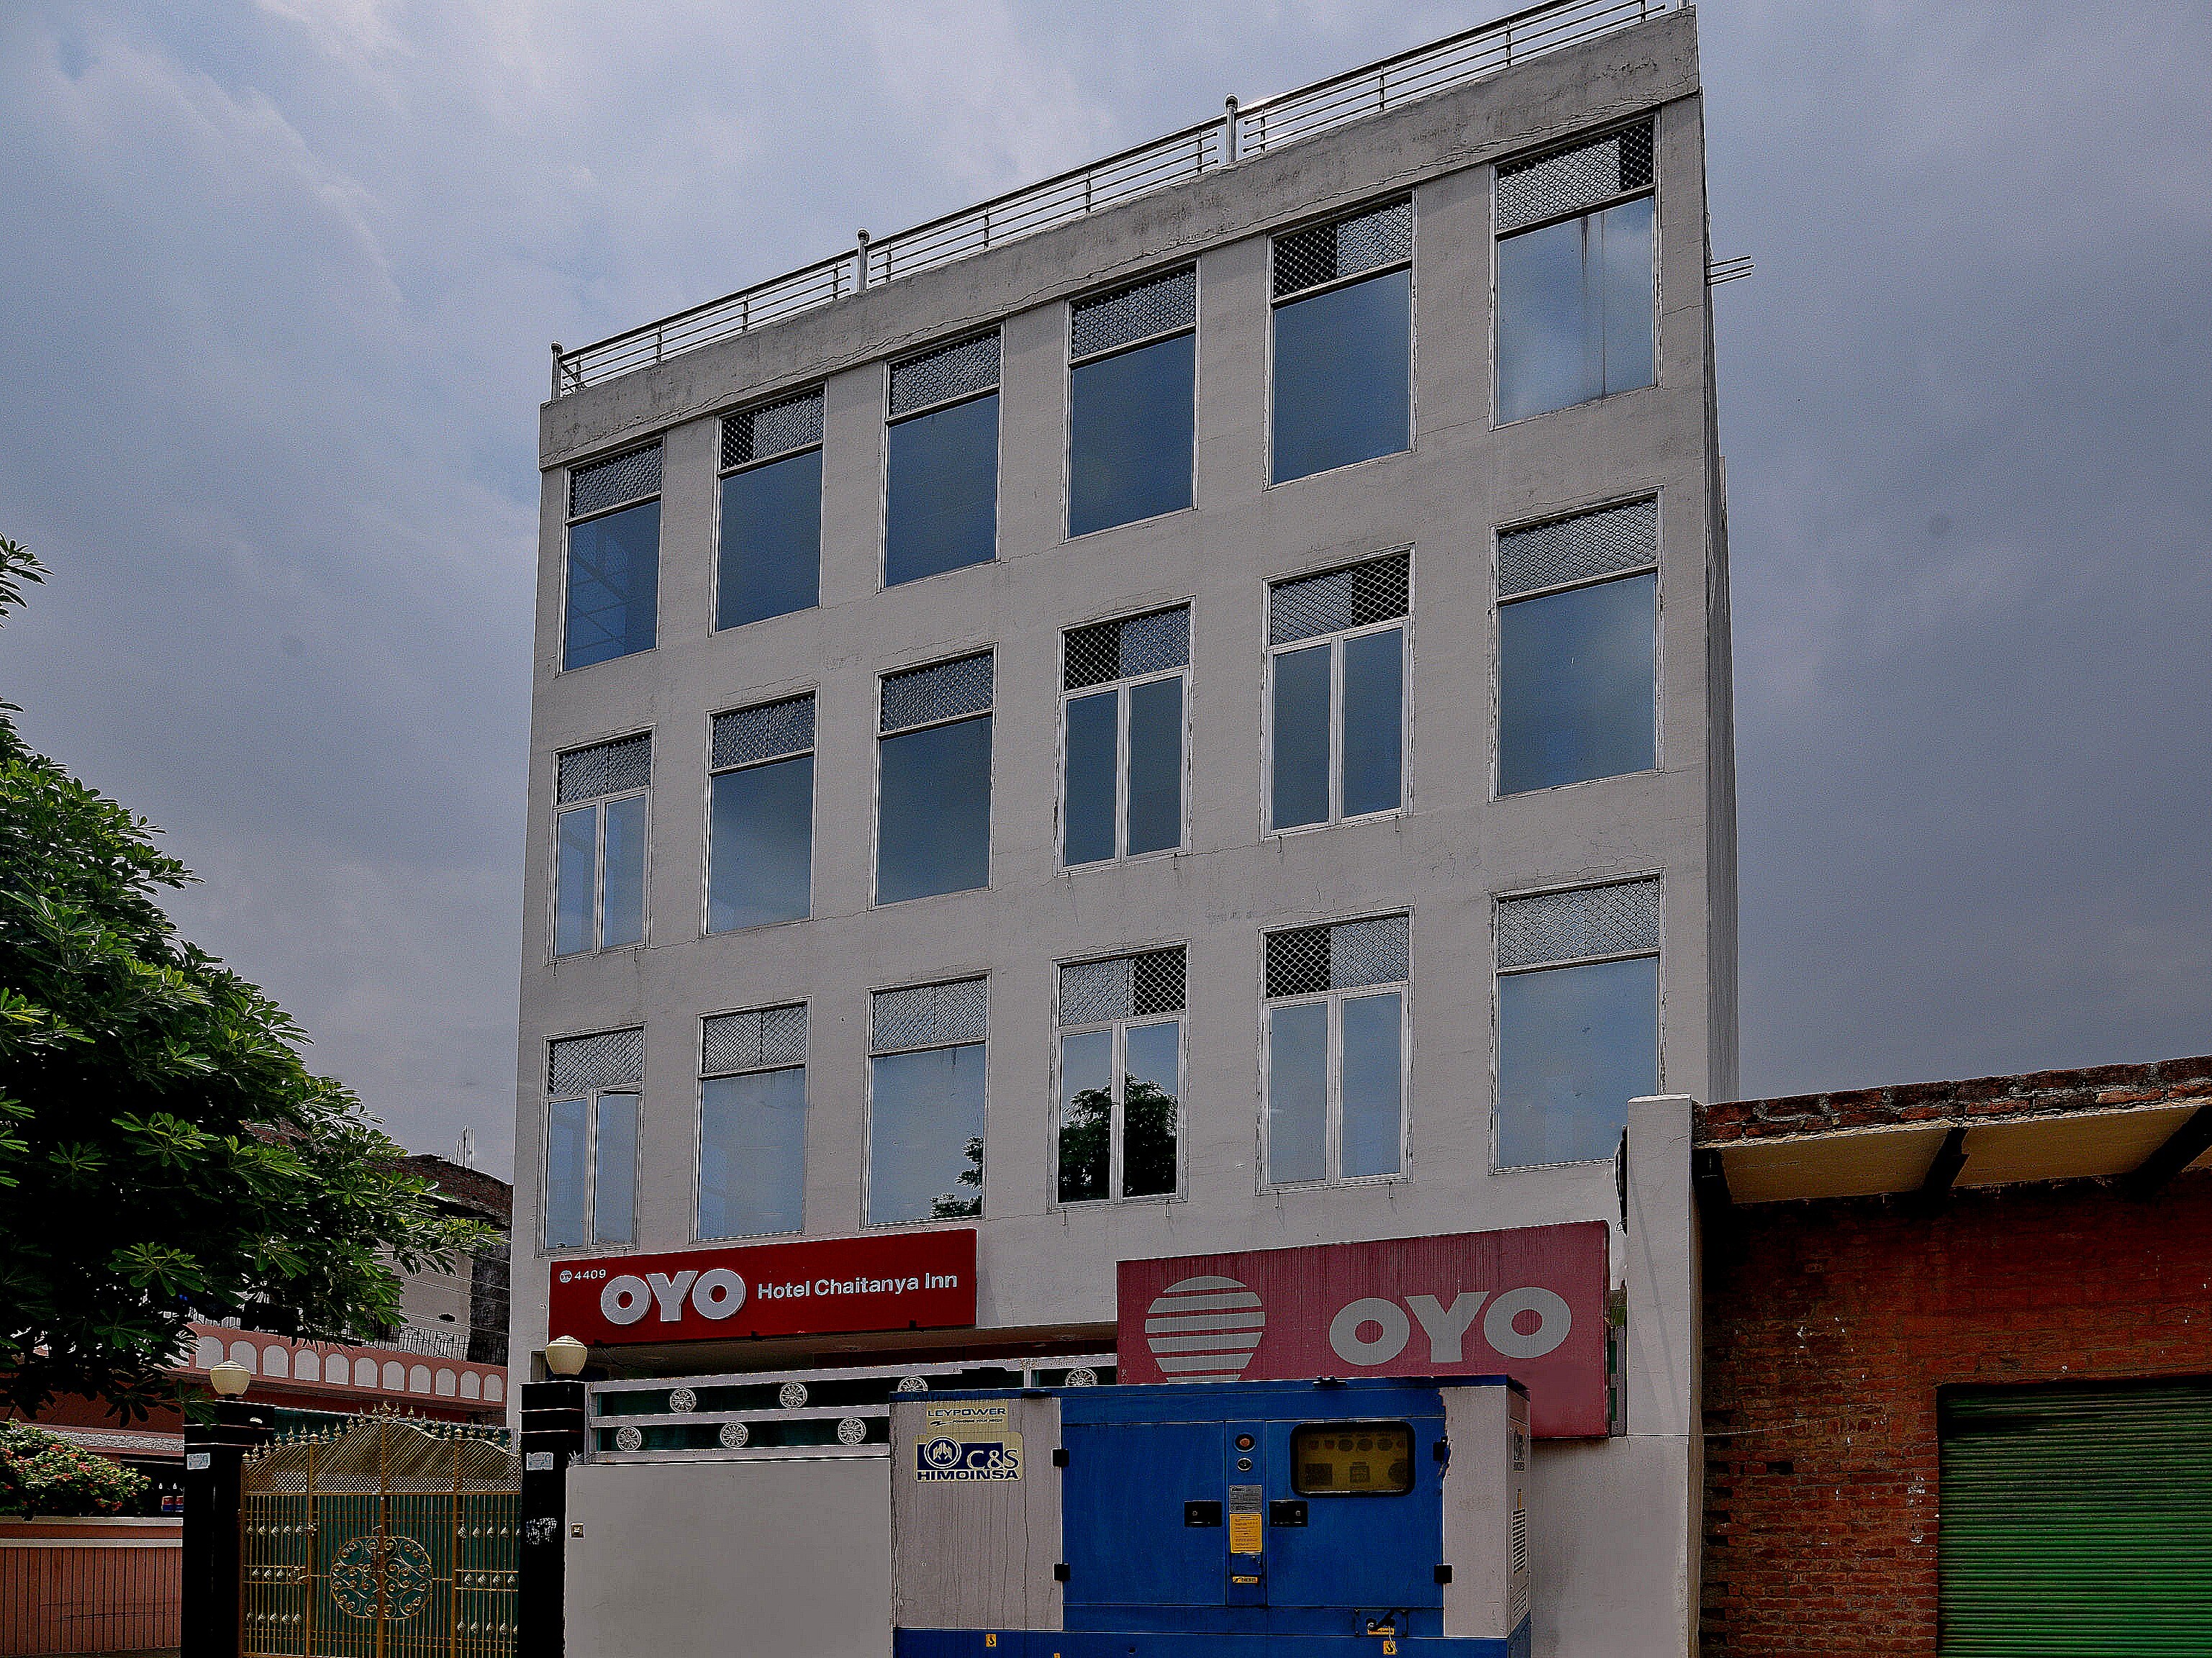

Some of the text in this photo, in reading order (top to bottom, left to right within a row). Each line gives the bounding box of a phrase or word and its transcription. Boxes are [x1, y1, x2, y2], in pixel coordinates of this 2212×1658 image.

[574, 1269, 607, 1280] 4409
[758, 1272, 958, 1300] Hotel Chaitanya Inn
[601, 1269, 746, 1325] OYO
[1329, 1287, 1572, 1366] OYO
[928, 1408, 1007, 1417] LEYPOWER
[966, 1449, 1020, 1470] C&S
[917, 1469, 1020, 1482] HIMOINSA
